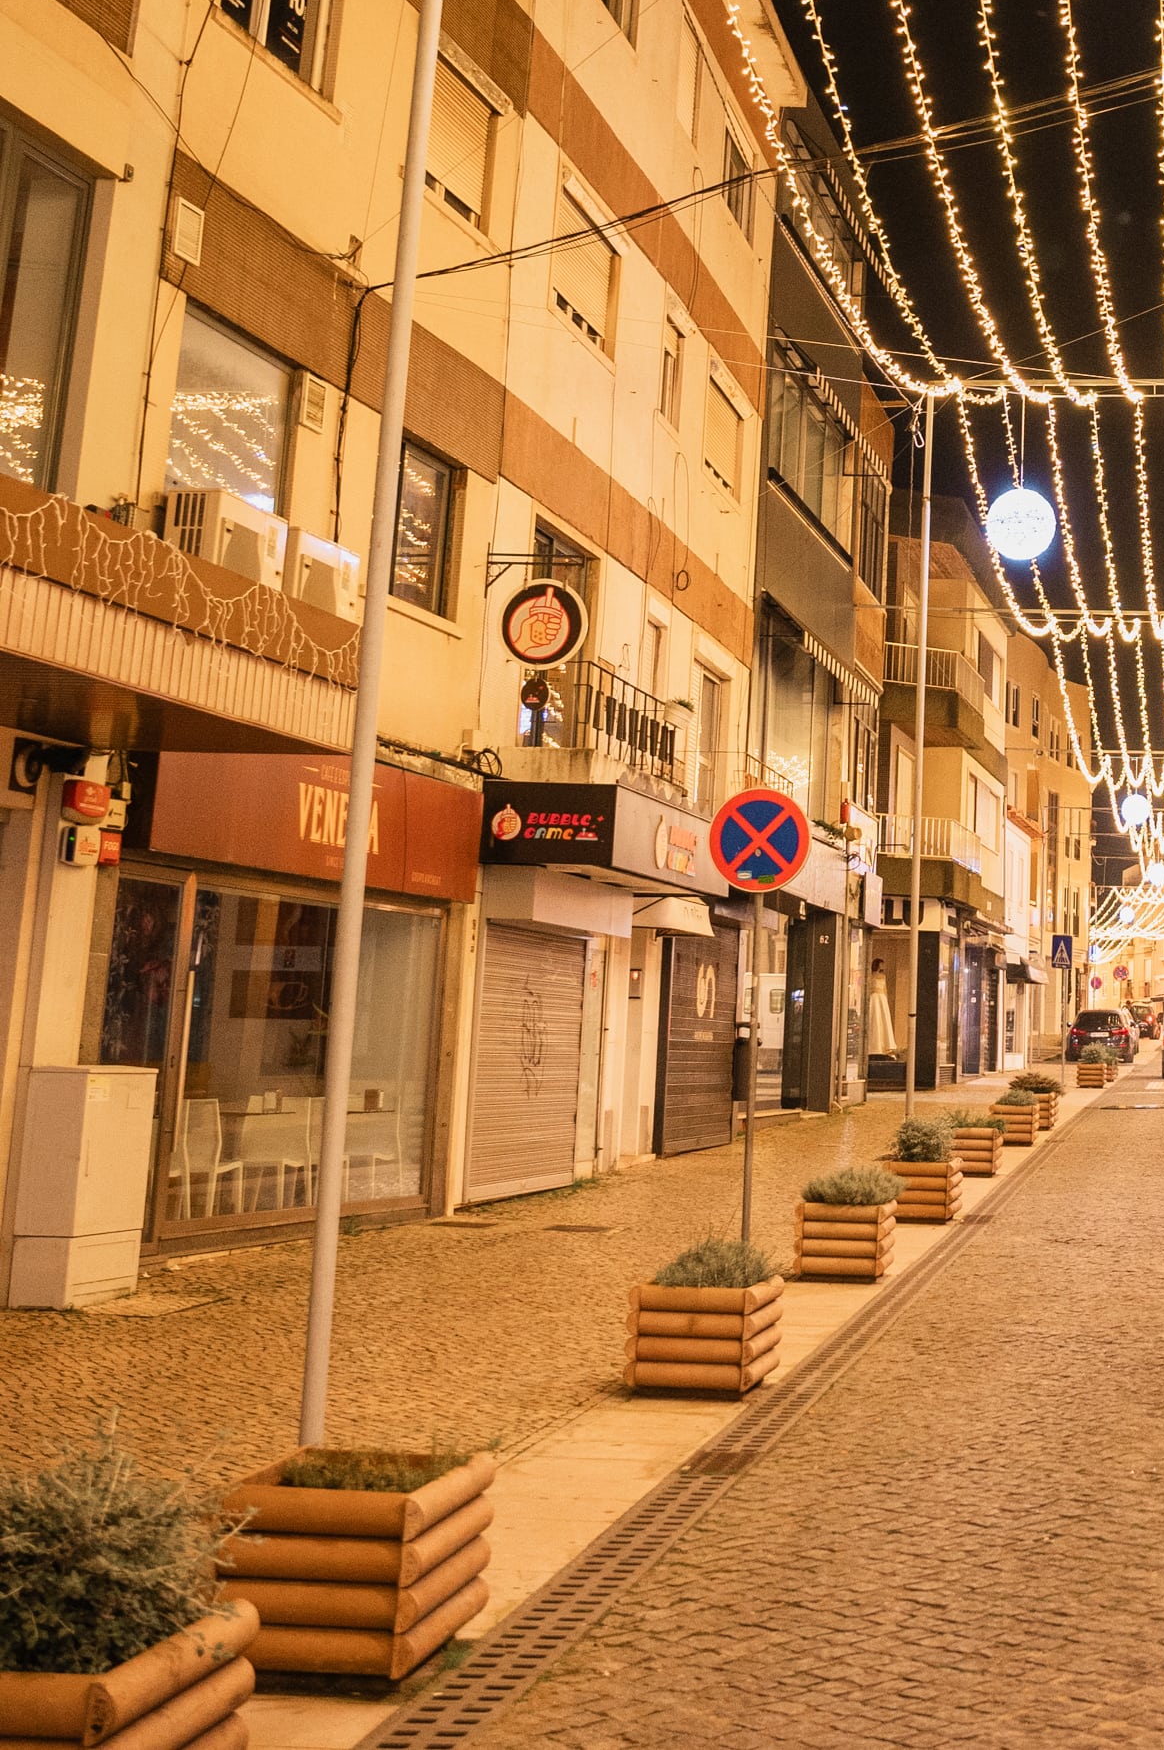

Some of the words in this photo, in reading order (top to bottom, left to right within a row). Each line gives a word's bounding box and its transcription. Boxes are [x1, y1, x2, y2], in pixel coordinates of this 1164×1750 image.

[299, 782, 379, 855] VENEA
[527, 812, 591, 826] BUBBLE
[524, 827, 573, 840] GAME
[880, 898, 925, 927] LU
